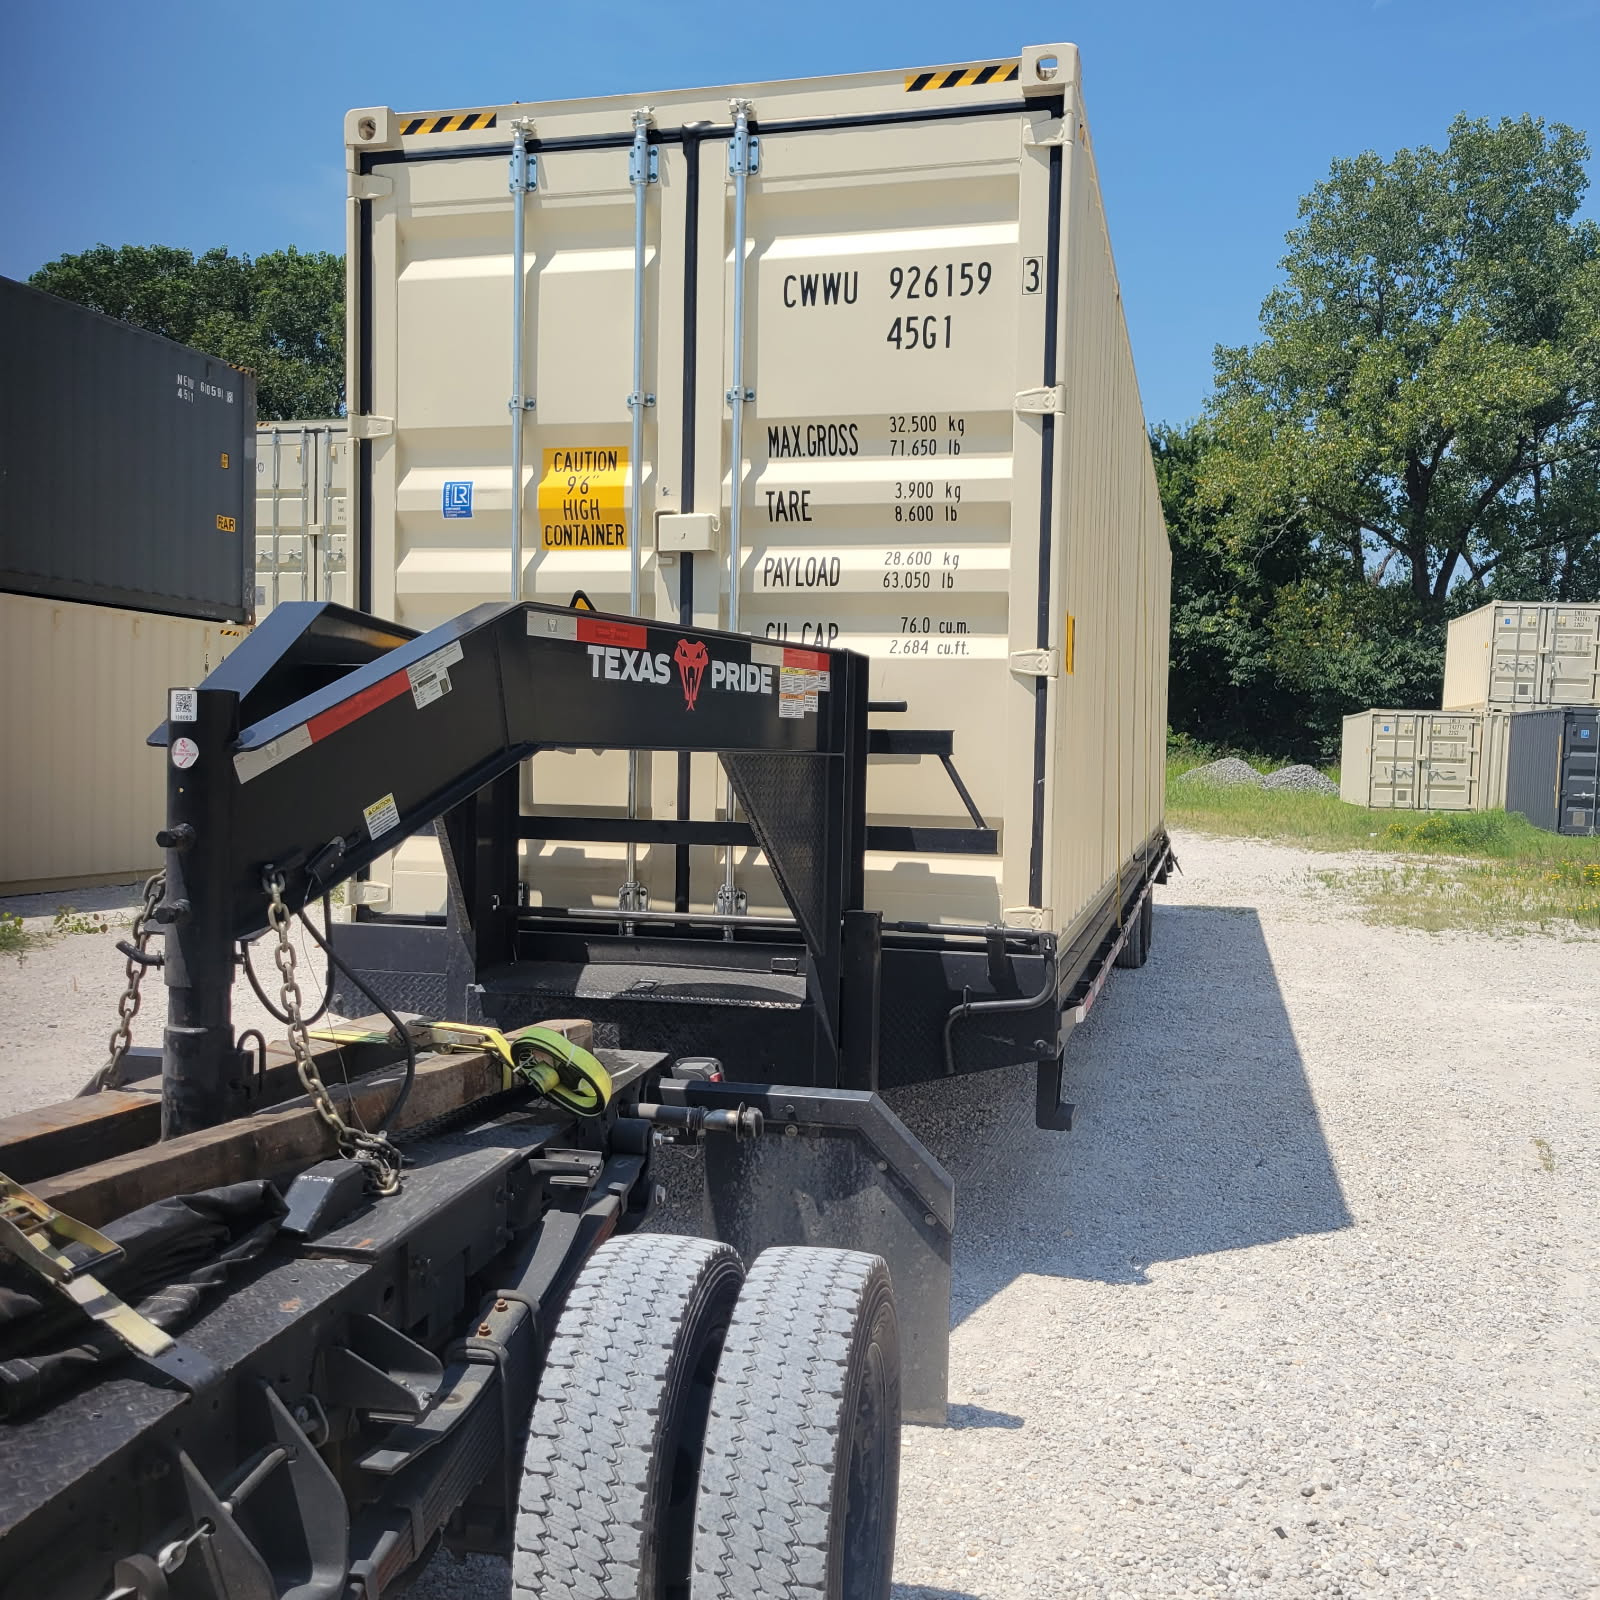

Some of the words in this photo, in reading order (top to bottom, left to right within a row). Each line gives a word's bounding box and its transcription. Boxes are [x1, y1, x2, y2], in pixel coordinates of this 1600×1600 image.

[783, 271, 859, 308] CWWU
[889, 261, 992, 299] 926159
[1024, 258, 1041, 293] 3
[886, 315, 952, 350] 45G1
[948, 415, 965, 436] kg
[767, 423, 859, 459] MAX.GROSS
[948, 439, 961, 455] lb
[553, 450, 618, 473] CAUTION
[945, 481, 961, 503] kg
[562, 498, 601, 521] HIGH
[765, 490, 813, 523] TARE
[944, 505, 958, 521] lb
[544, 523, 625, 546] CONTAINER
[763, 556, 841, 588] PAYLOAD
[942, 551, 960, 570] kg
[941, 571, 954, 588] lb
[900, 616, 931, 634] 76.0
[938, 618, 971, 634] cu.m.
[937, 640, 970, 656] cu.ft.
[587, 644, 671, 685] TEXAS
[711, 660, 773, 694] PRIDE
